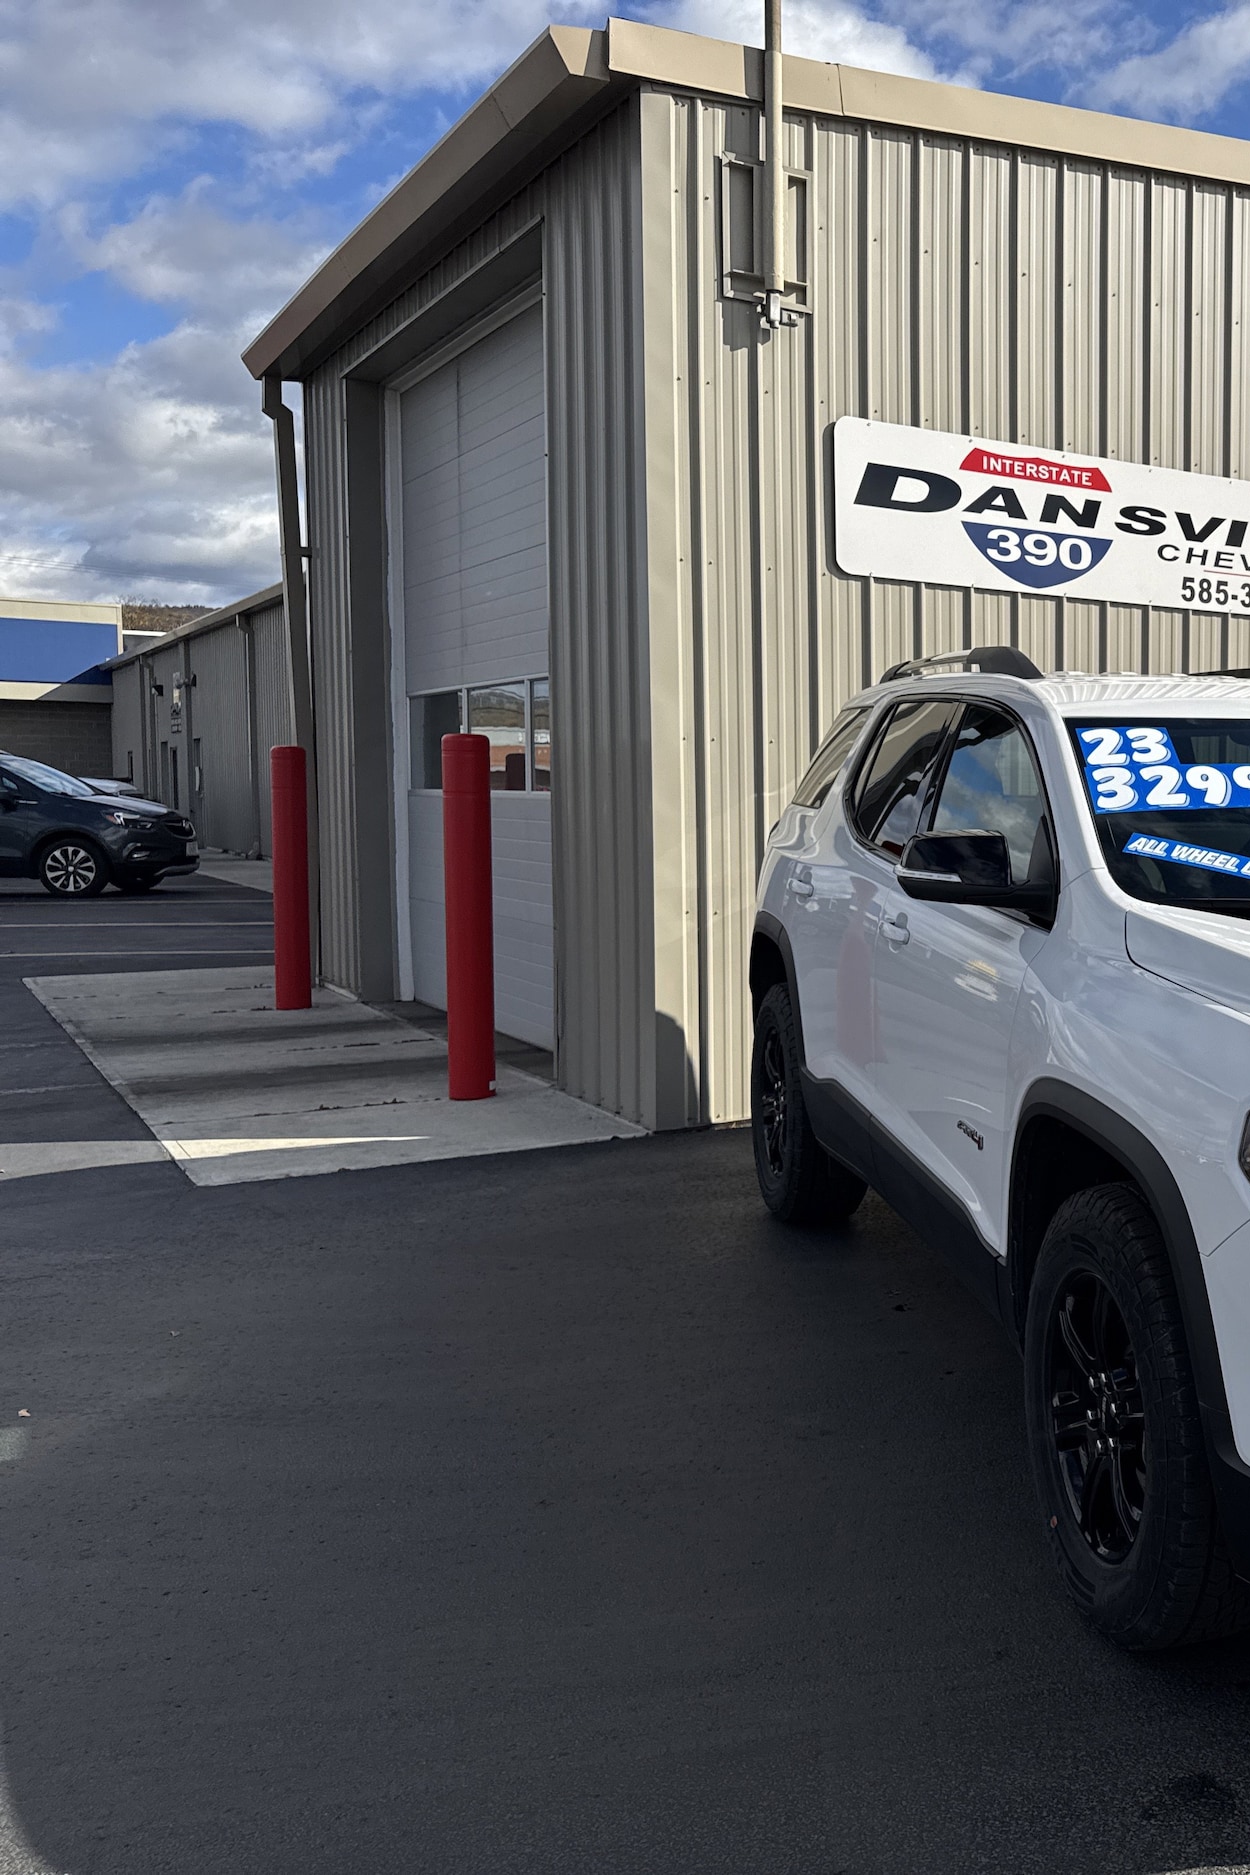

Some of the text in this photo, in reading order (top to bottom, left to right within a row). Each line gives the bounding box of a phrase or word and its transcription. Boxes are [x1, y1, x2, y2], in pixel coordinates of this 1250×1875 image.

[981, 454, 1093, 487] INTERSTATE
[985, 528, 1093, 572] 390
[1080, 727, 1171, 765] 23
[1127, 837, 1169, 857] ALL
[1171, 844, 1238, 873] WHEEL
